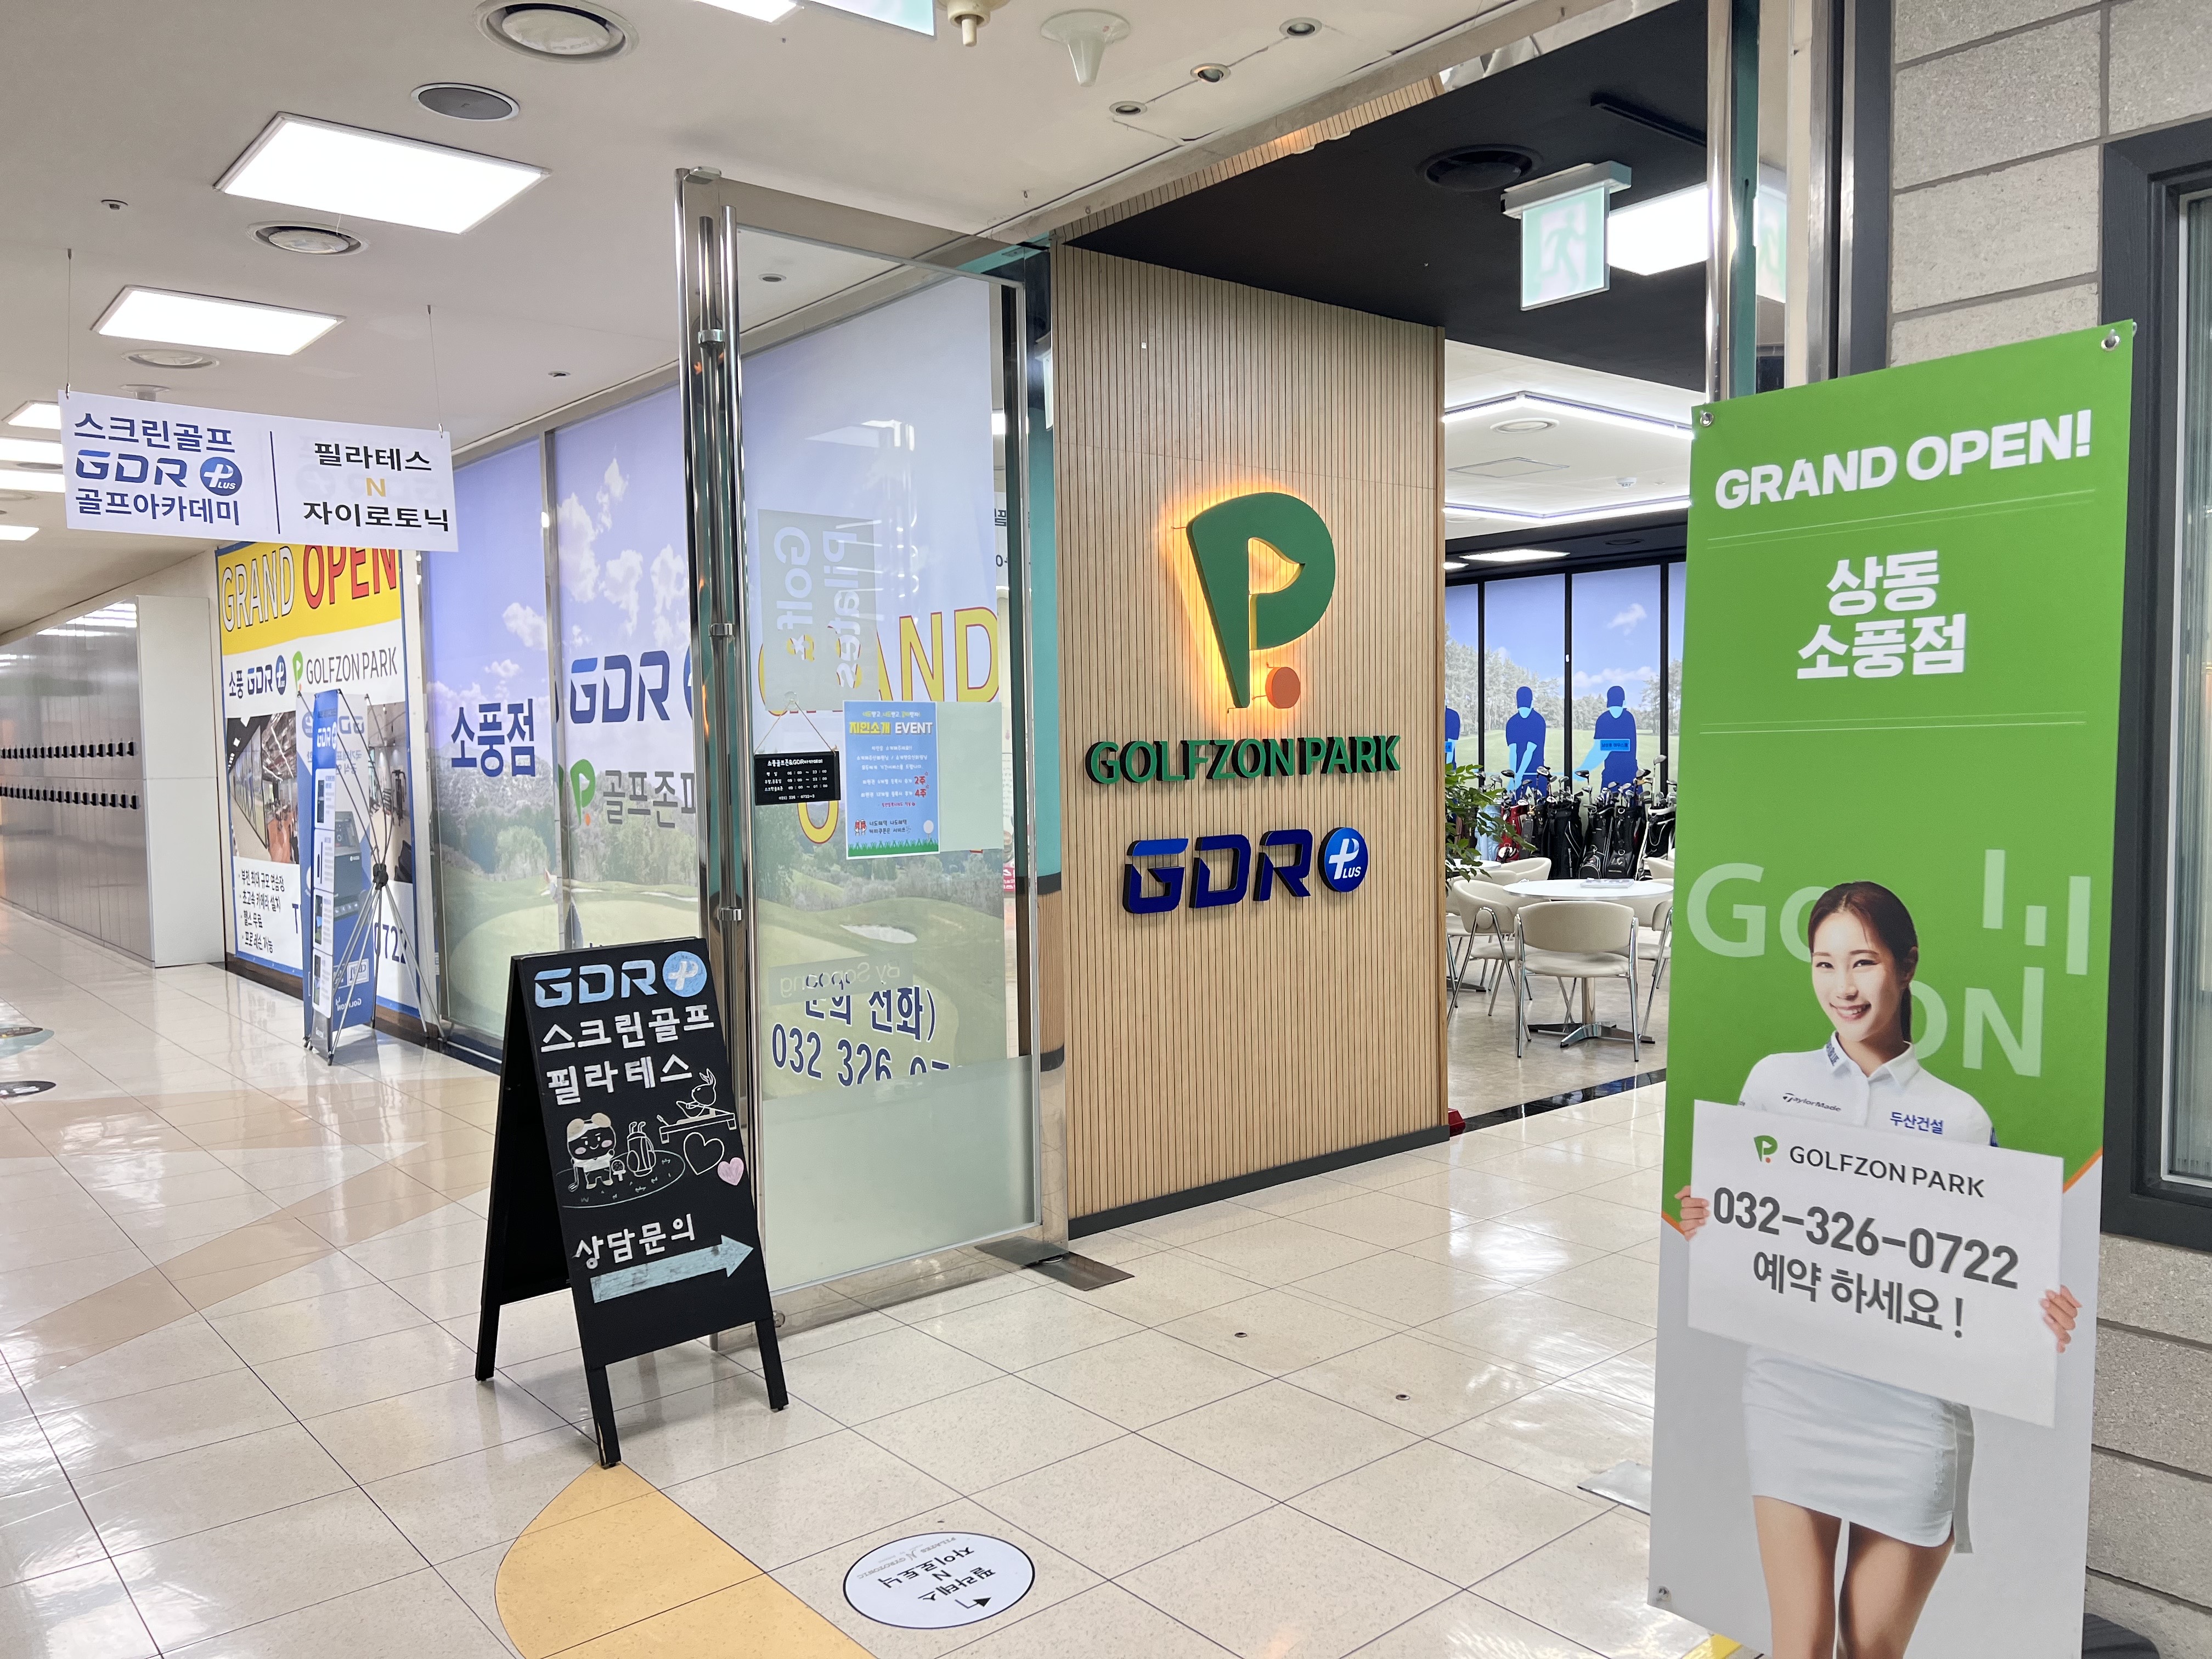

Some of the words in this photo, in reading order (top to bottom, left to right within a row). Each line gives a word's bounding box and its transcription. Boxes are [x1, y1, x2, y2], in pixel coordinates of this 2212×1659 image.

[74, 413, 236, 453] 스크린골프
[314, 442, 432, 472] 필라테스
[76, 449, 188, 488] GDR
[1715, 446, 1897, 510] GRAND
[1906, 409, 2092, 481] OPEN!
[75, 488, 240, 526] 골프아카데미
[366, 477, 386, 496] N
[303, 501, 449, 532] 자이로토닉
[222, 546, 295, 631] GRAND
[303, 545, 397, 609] OPEN
[1826, 549, 1939, 616] 상동
[306, 653, 359, 685] GOLFZON
[363, 647, 397, 679] PARK
[1797, 613, 1967, 680] 소풍점
[229, 670, 243, 699] 소풍
[247, 664, 273, 695] GDR
[570, 650, 670, 724] GDR
[451, 698, 535, 777] 소풍점
[849, 721, 891, 735] 지인소개
[895, 722, 933, 735] EVENT
[1085, 737, 1295, 785] GOLFZON
[1297, 735, 1402, 775] PARK
[1122, 829, 1313, 915] GDR
[534, 959, 658, 1008] GDR
[541, 1004, 714, 1052] 스크린골프
[772, 1024, 822, 1081] 032
[547, 1053, 692, 1105] 필라테스
[1782, 1092, 1842, 1113] TaylorMade
[1890, 1111, 1944, 1135] 두산건설
[1790, 1145, 1905, 1183] GOLFZON
[1912, 1167, 1985, 1198] PARK
[572, 1214, 695, 1269] 상담문의
[1713, 1187, 2019, 1289] 032-326-0722
[1754, 1251, 1822, 1302] 예약
[878, 1547, 975, 1588] 자이로토닉
[918, 1567, 996, 1601] 필라테스
